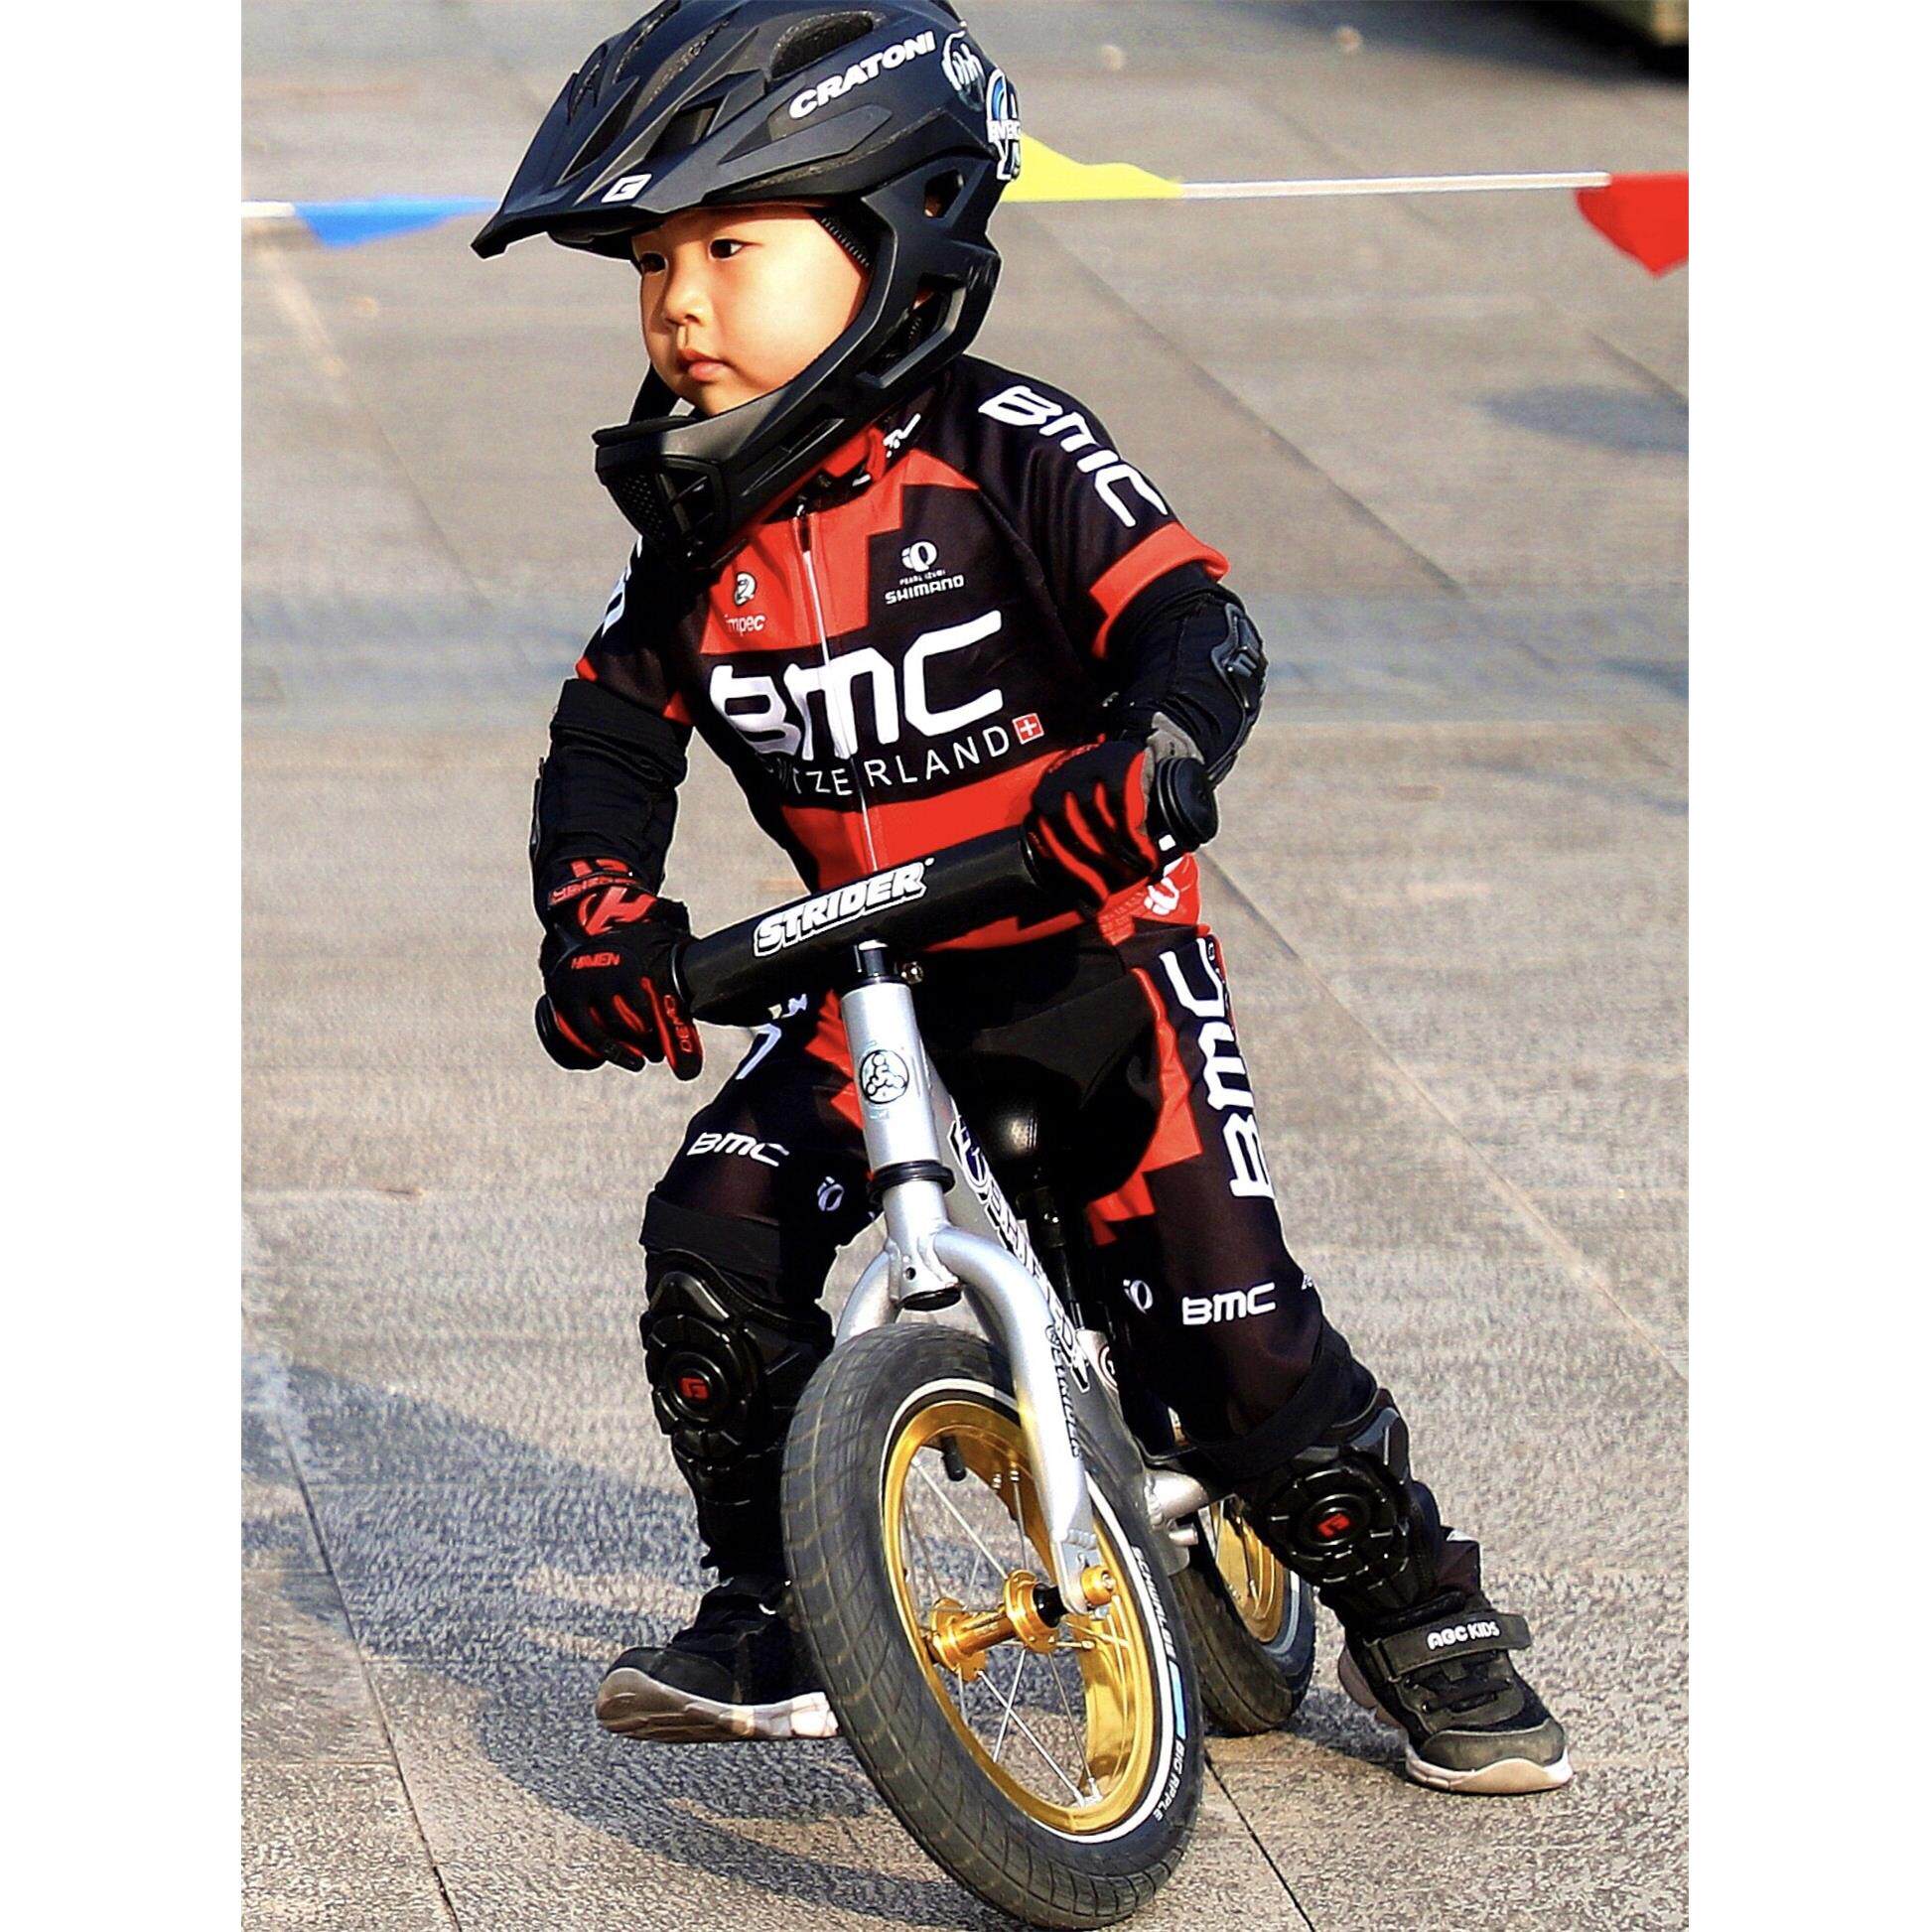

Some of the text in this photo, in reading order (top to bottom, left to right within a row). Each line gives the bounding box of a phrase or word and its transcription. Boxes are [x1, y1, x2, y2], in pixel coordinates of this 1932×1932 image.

[789, 31, 936, 118] CRATONI
[978, 385, 1168, 527] BMC
[885, 574, 964, 605] SHIMANO
[710, 610, 1003, 760] BMC
[754, 861, 928, 957] STRIDER
[687, 1132, 790, 1168] BMC
[1181, 1282, 1277, 1325] BMC
[1467, 1621, 1500, 1640] KIDS
[1153, 1739, 1185, 1823] BIG APPLE
